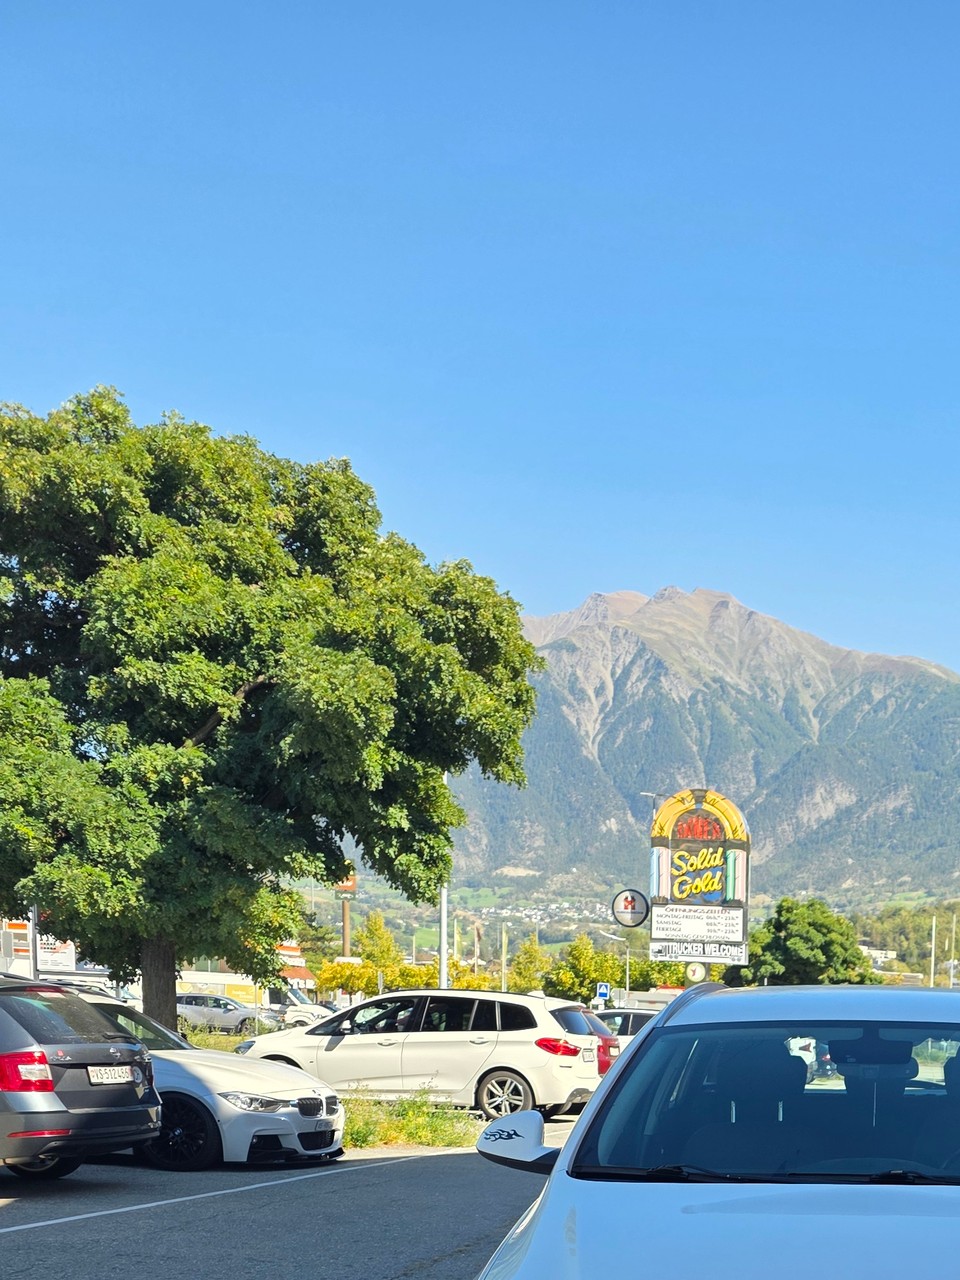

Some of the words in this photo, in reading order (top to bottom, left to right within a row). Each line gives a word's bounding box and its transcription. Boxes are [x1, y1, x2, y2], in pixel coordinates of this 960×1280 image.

[671, 847, 725, 876] Solid
[673, 871, 722, 899] Gold
[667, 942, 703, 955] TRUCKER
